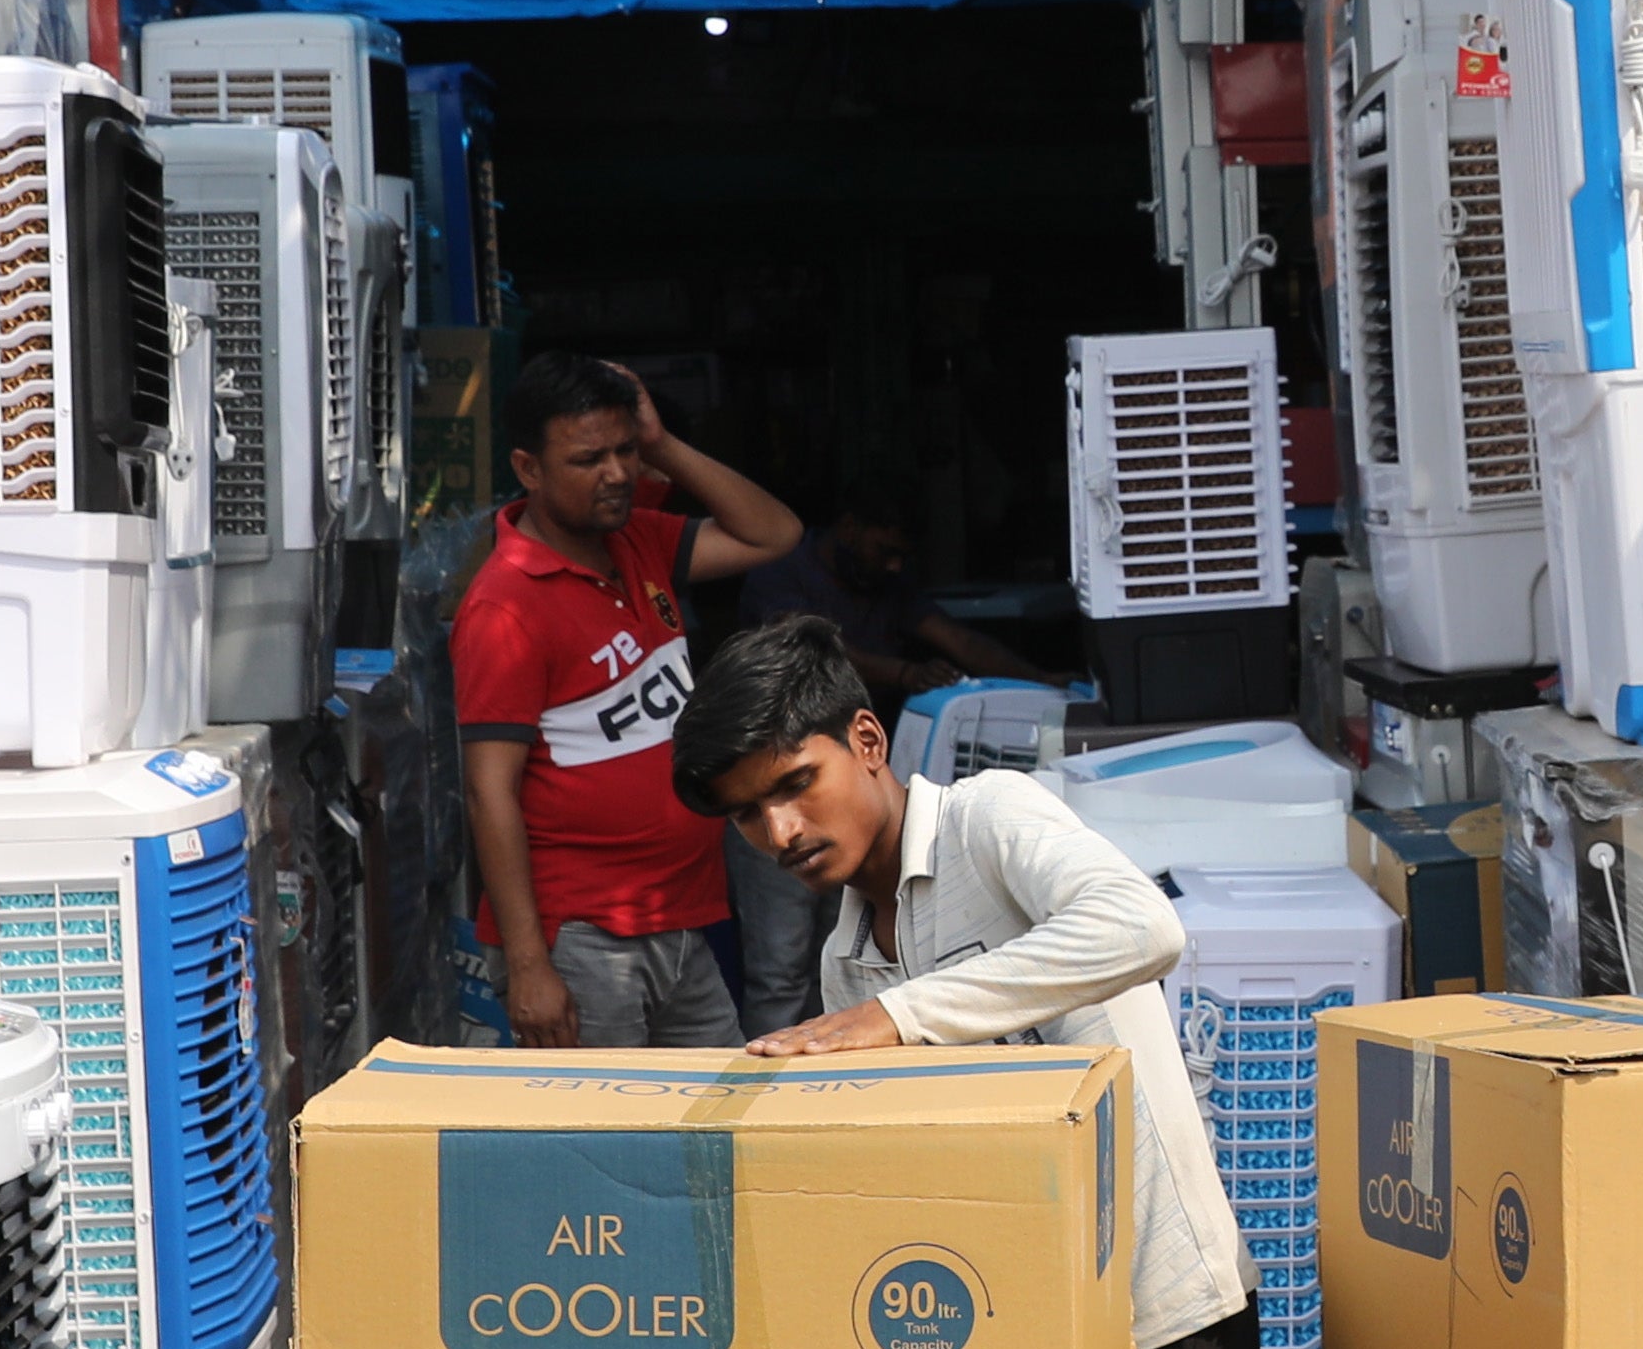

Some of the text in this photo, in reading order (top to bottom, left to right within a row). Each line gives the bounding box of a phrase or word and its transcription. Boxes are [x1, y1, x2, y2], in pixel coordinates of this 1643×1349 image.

[1367, 1172, 1444, 1235] COOLER
[546, 1215, 625, 1256] AIR
[469, 1283, 707, 1338] COOLER
[883, 1281, 962, 1319] 90 ltr.
[904, 1322, 940, 1334] Tank
